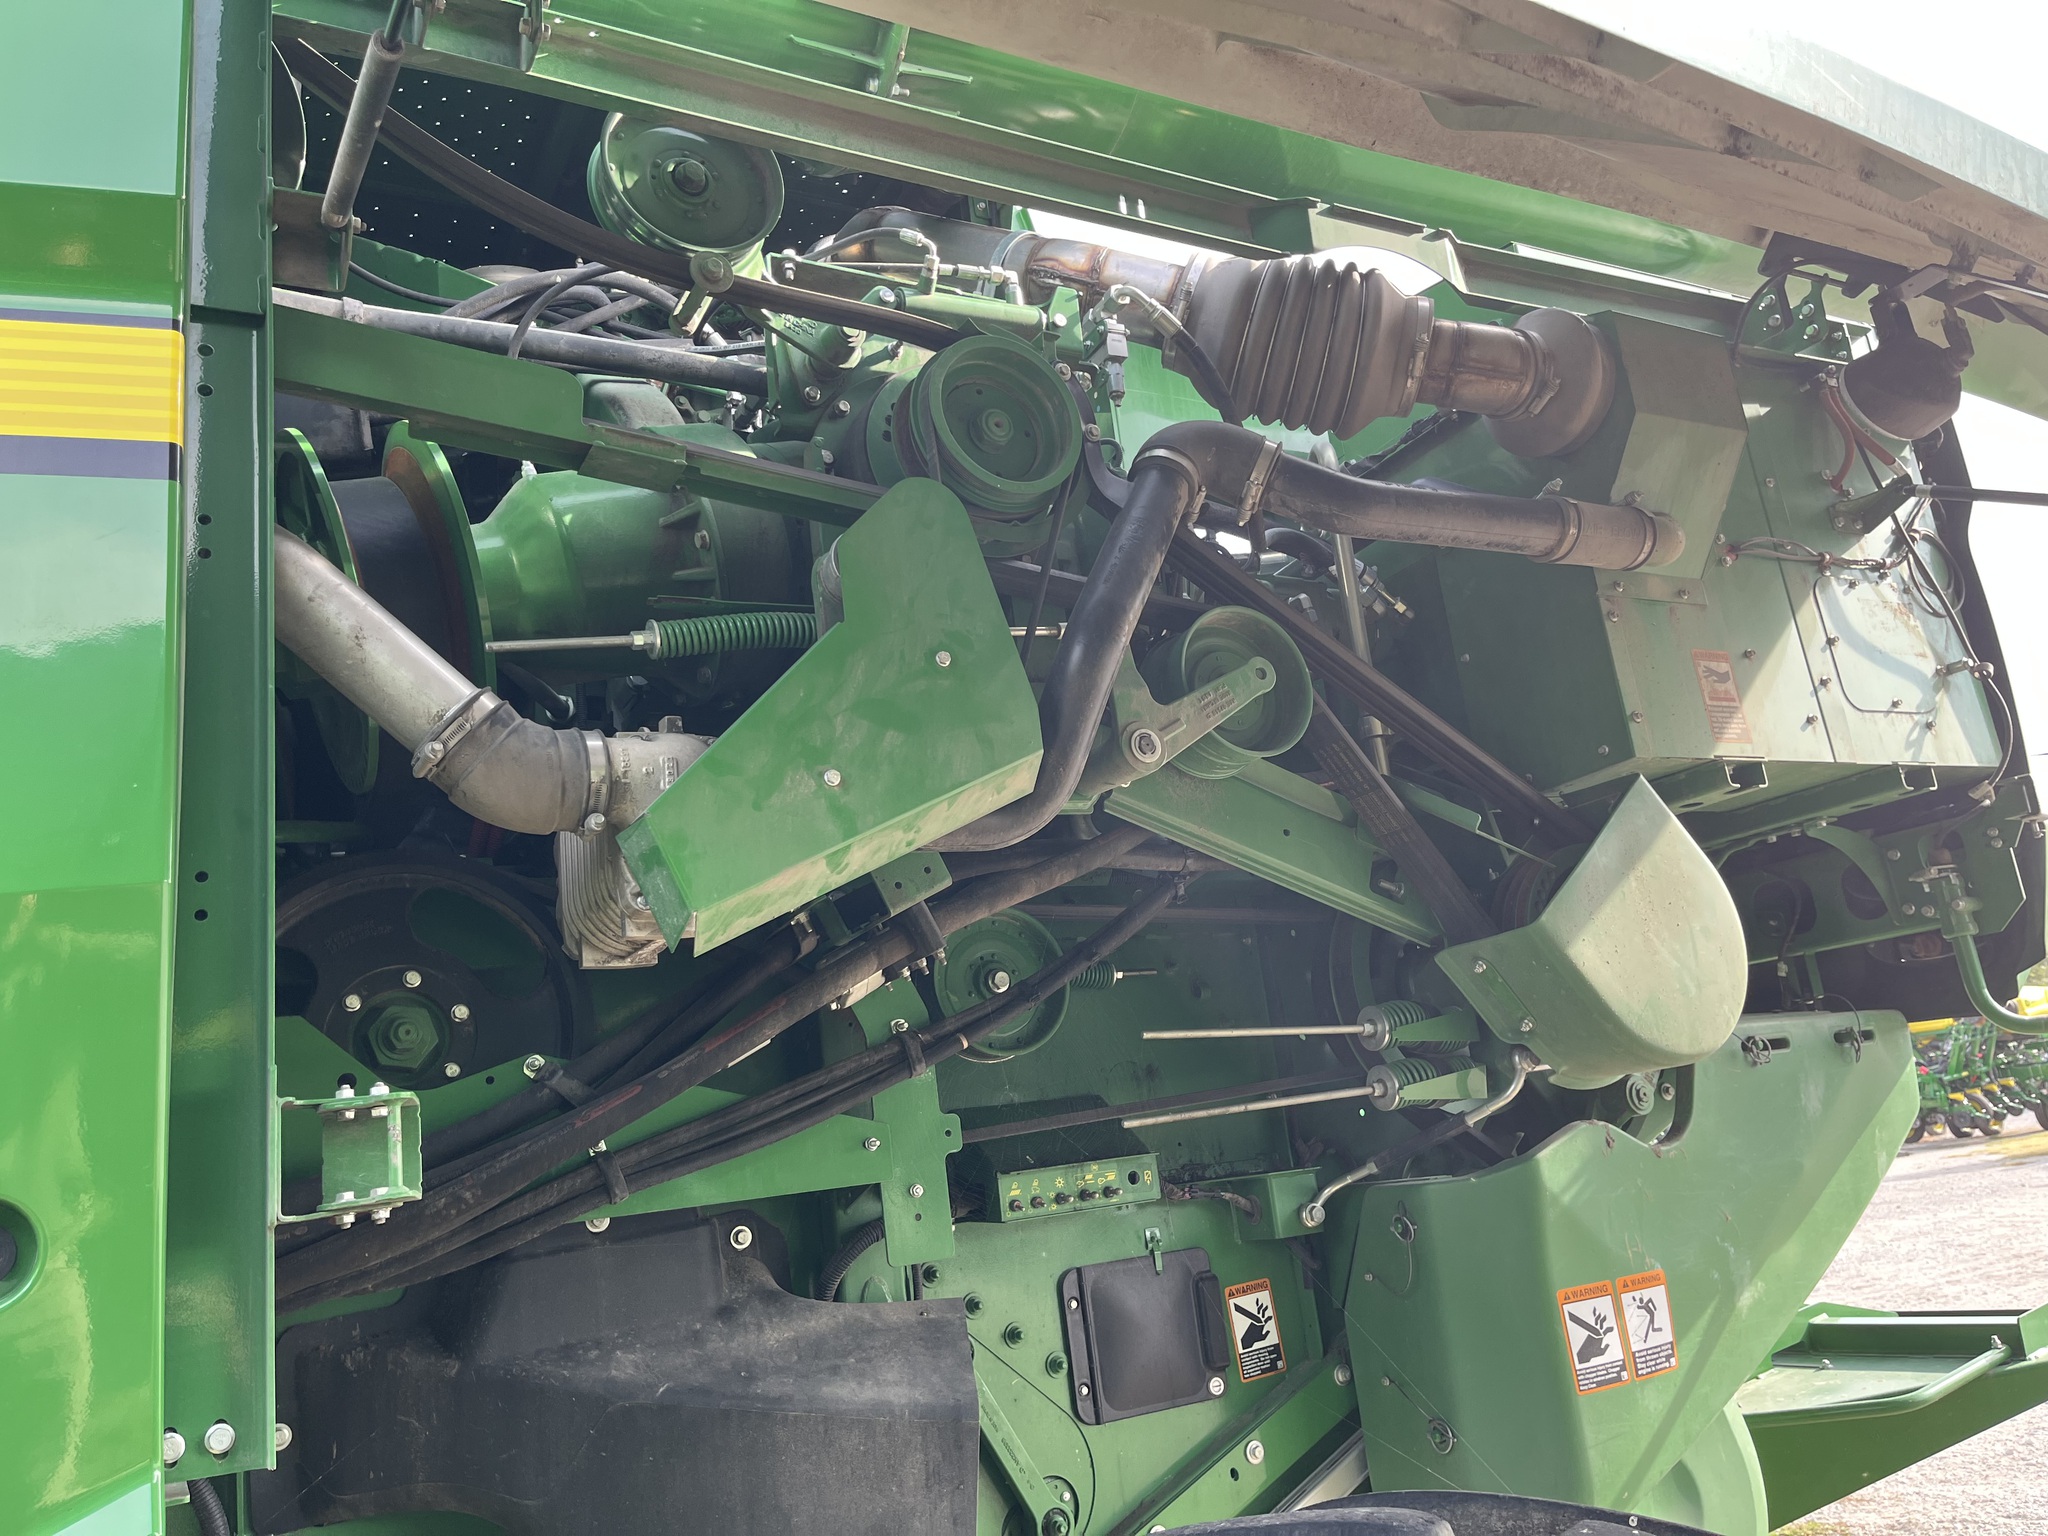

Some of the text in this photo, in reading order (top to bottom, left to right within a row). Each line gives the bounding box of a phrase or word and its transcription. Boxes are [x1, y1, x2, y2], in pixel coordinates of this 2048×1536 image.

[1234, 1280, 1269, 1295] WARNING
[1630, 1273, 1661, 1287] WARNING
[1570, 1284, 1608, 1300] WARNING
